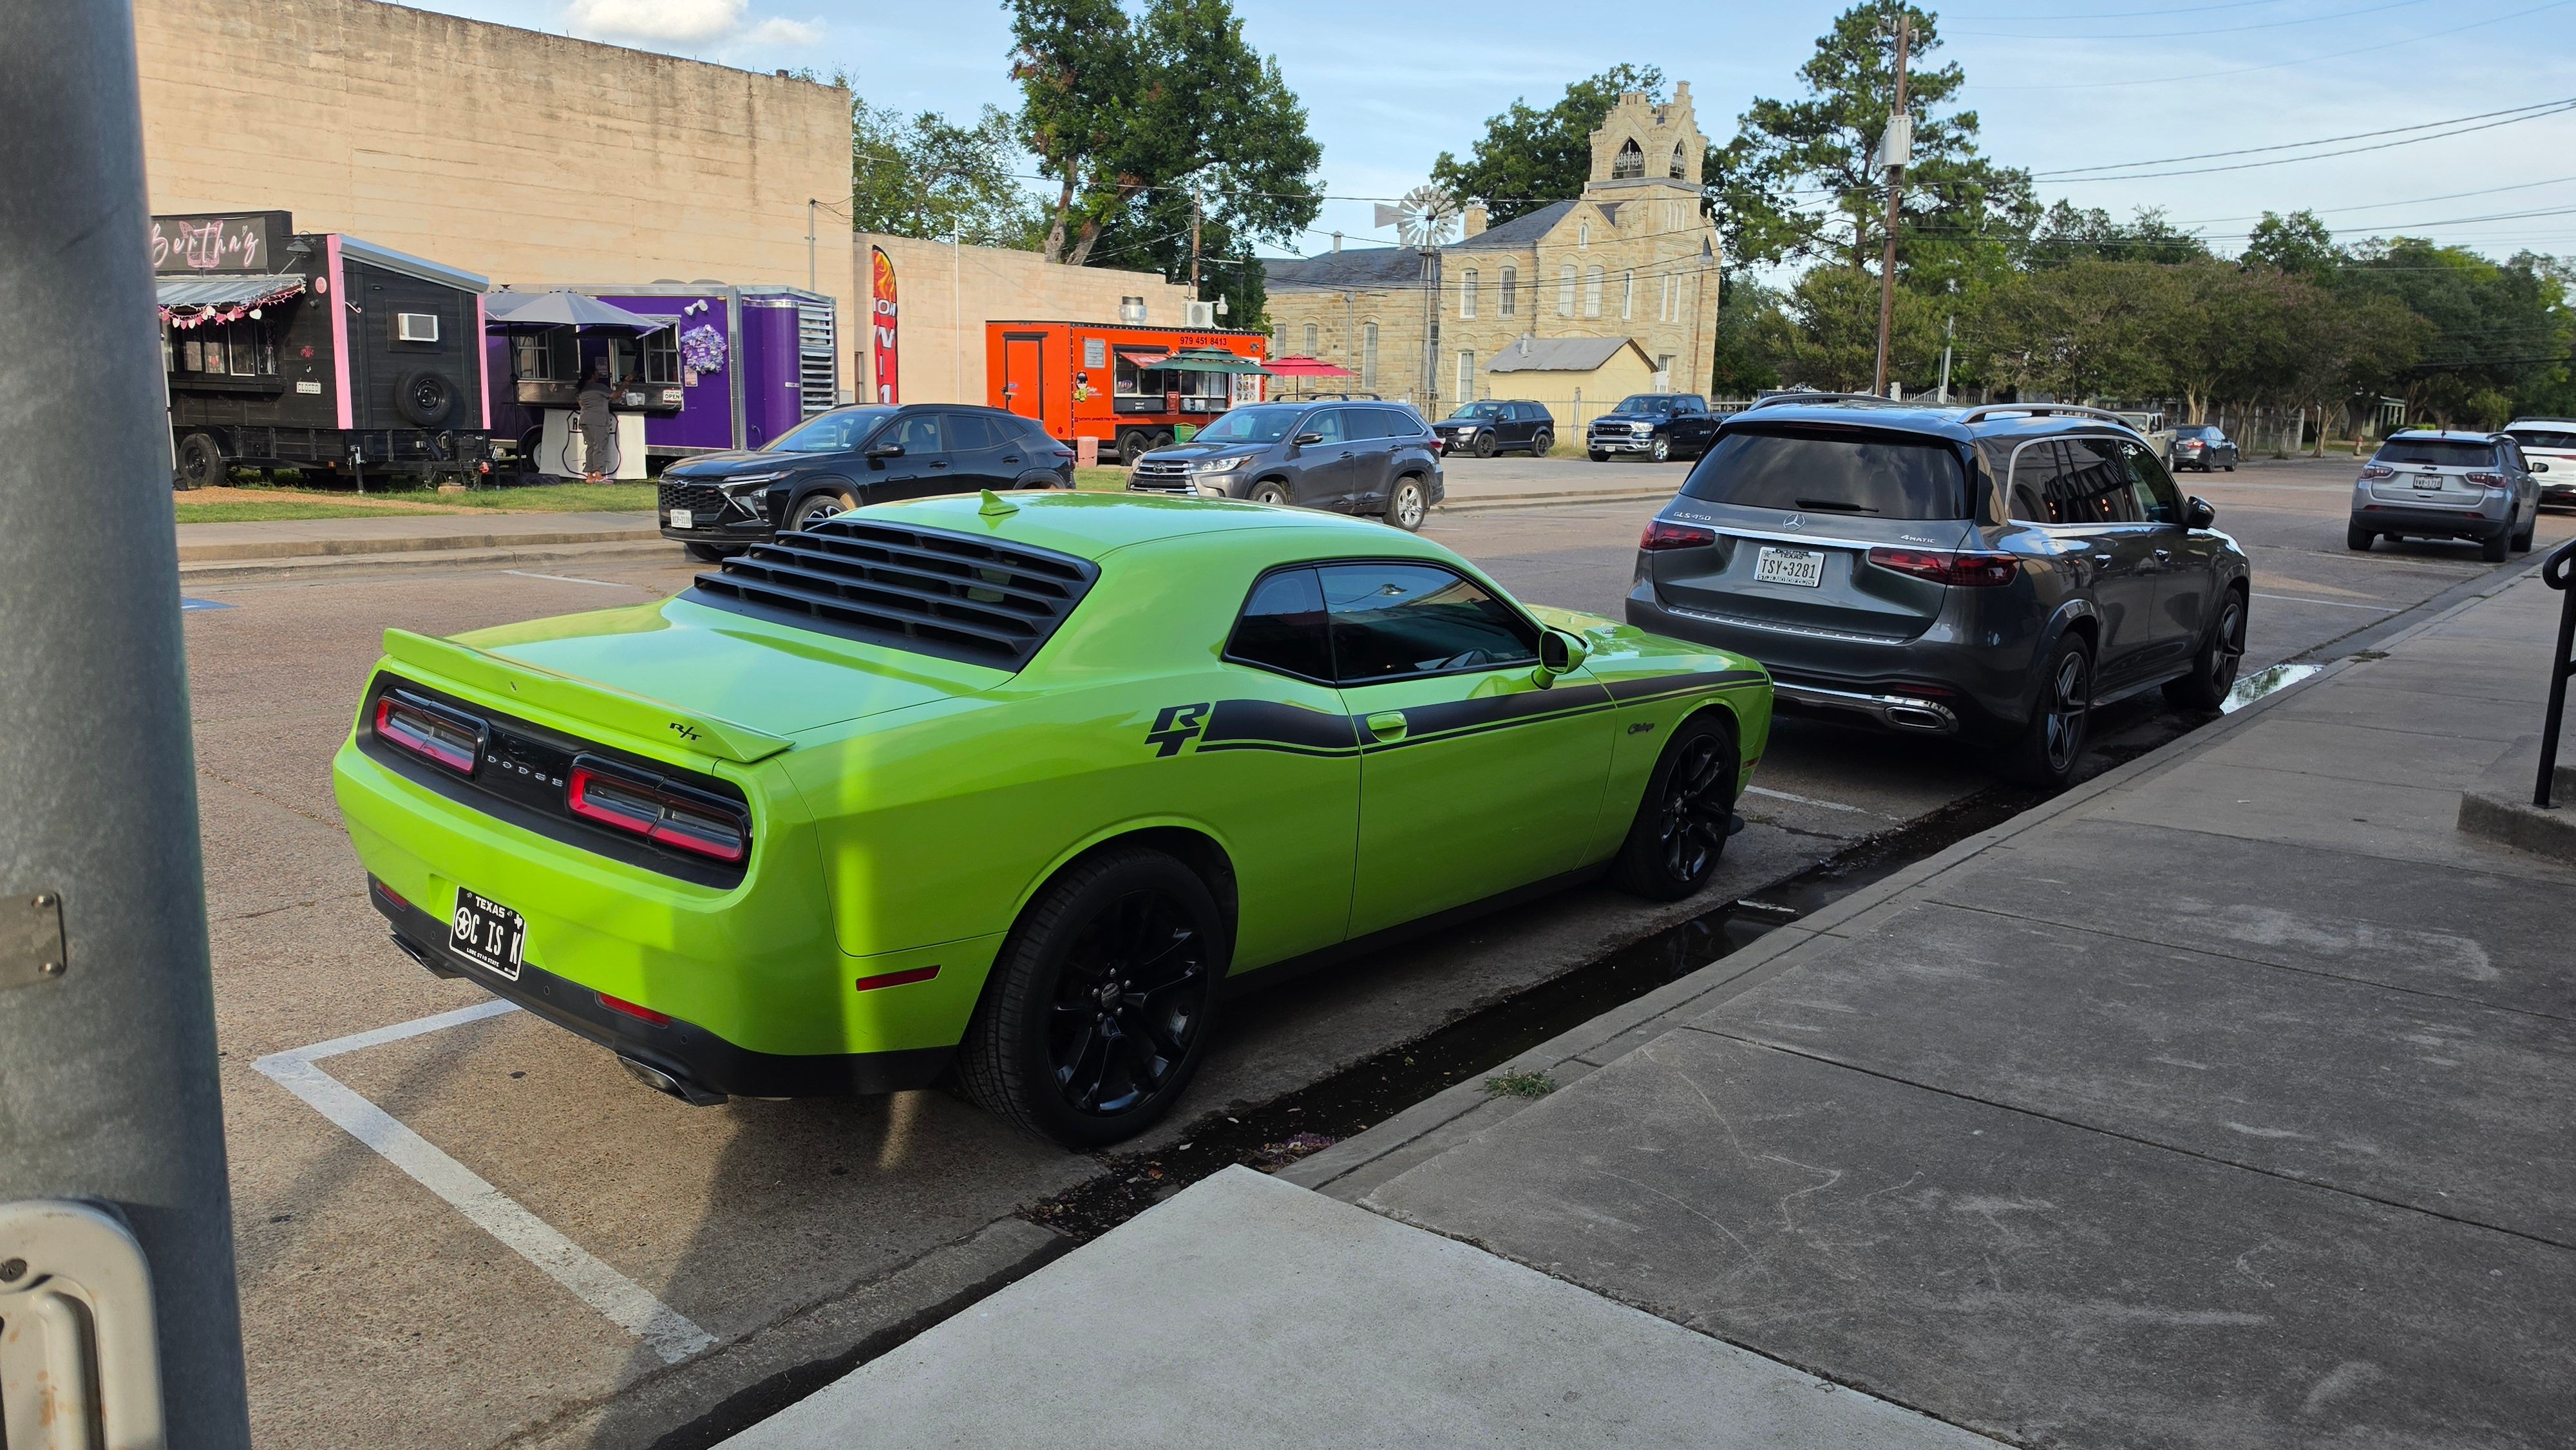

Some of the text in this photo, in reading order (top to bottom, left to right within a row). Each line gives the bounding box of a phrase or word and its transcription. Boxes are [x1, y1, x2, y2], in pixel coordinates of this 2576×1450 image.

[298, 383, 319, 392] CLOSED
[670, 722, 702, 740] R/T
[488, 755, 563, 787] DODGE
[476, 896, 505, 918] TEXAS
[485, 921, 504, 956] IS
[509, 932, 521, 964] K
